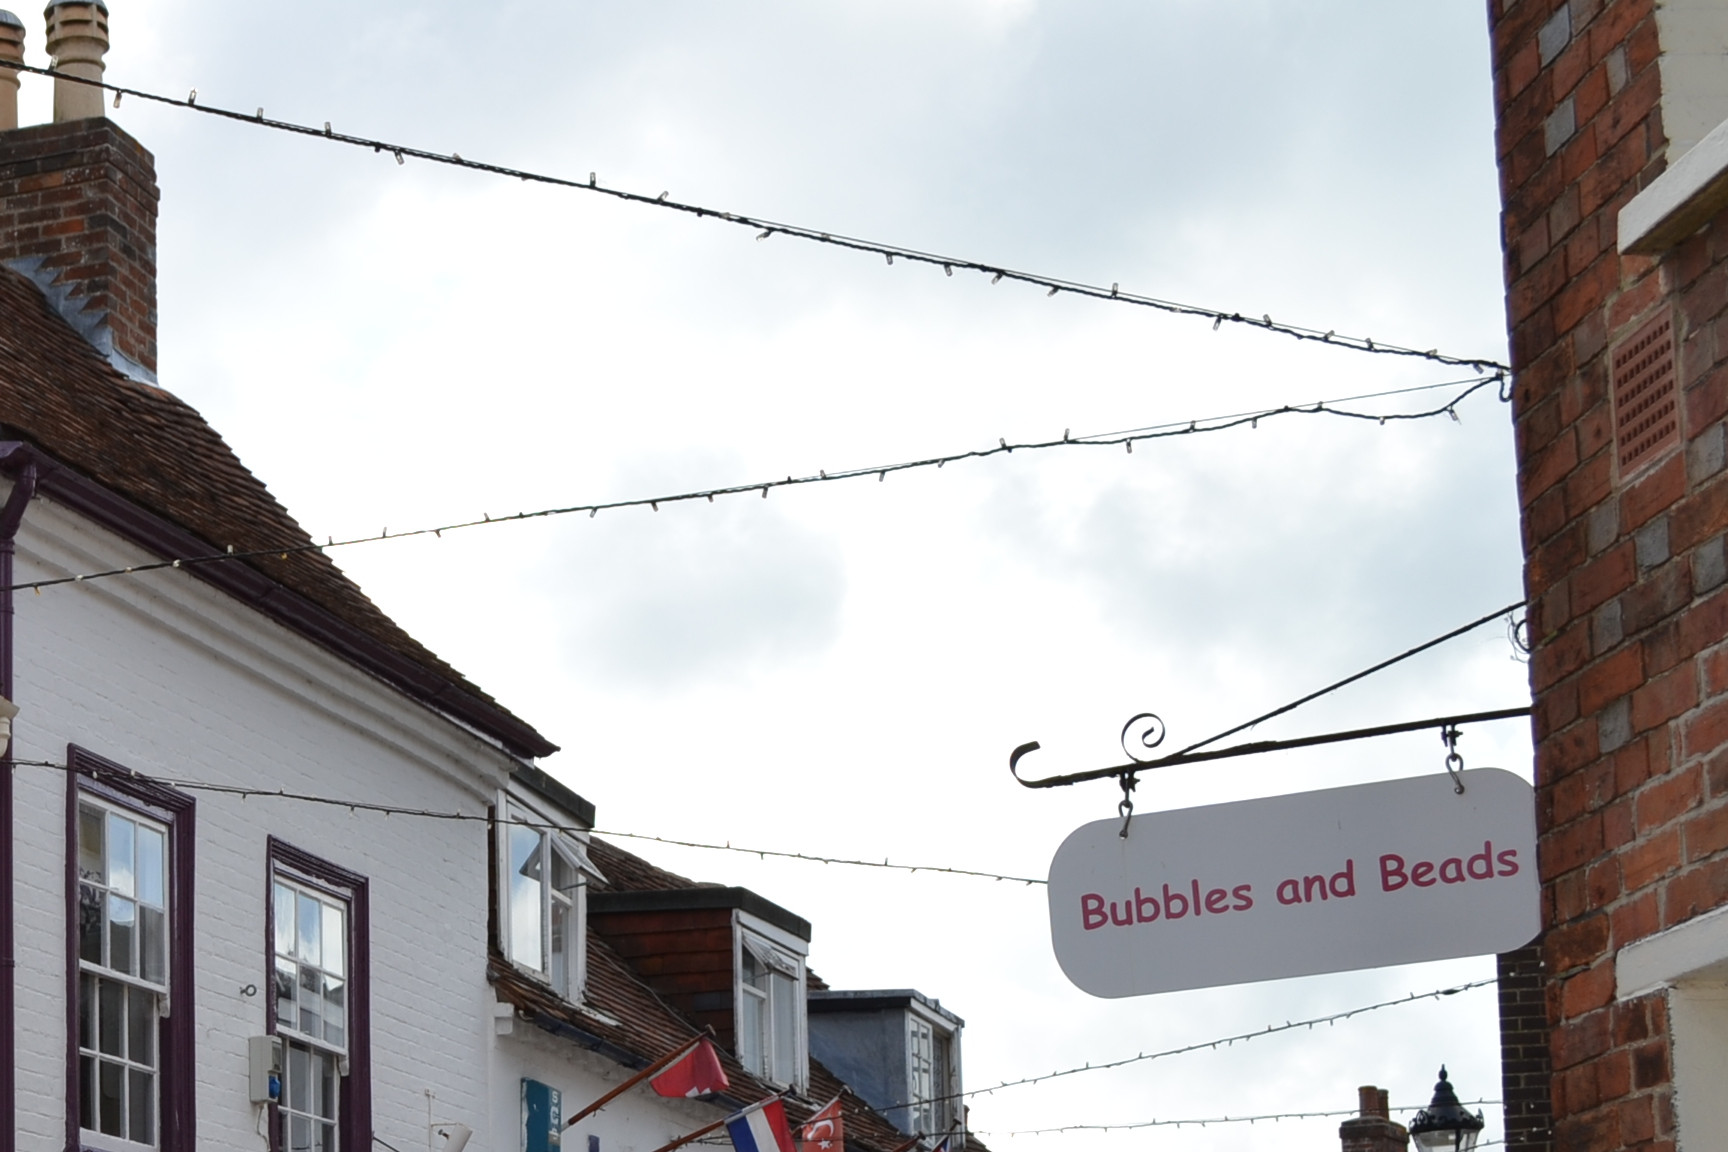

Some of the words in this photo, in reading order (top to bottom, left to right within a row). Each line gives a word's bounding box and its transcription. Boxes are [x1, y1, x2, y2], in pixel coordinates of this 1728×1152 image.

[1080, 878, 1253, 930] Bubbles
[1275, 858, 1357, 906] and
[1378, 840, 1520, 893] Beads
